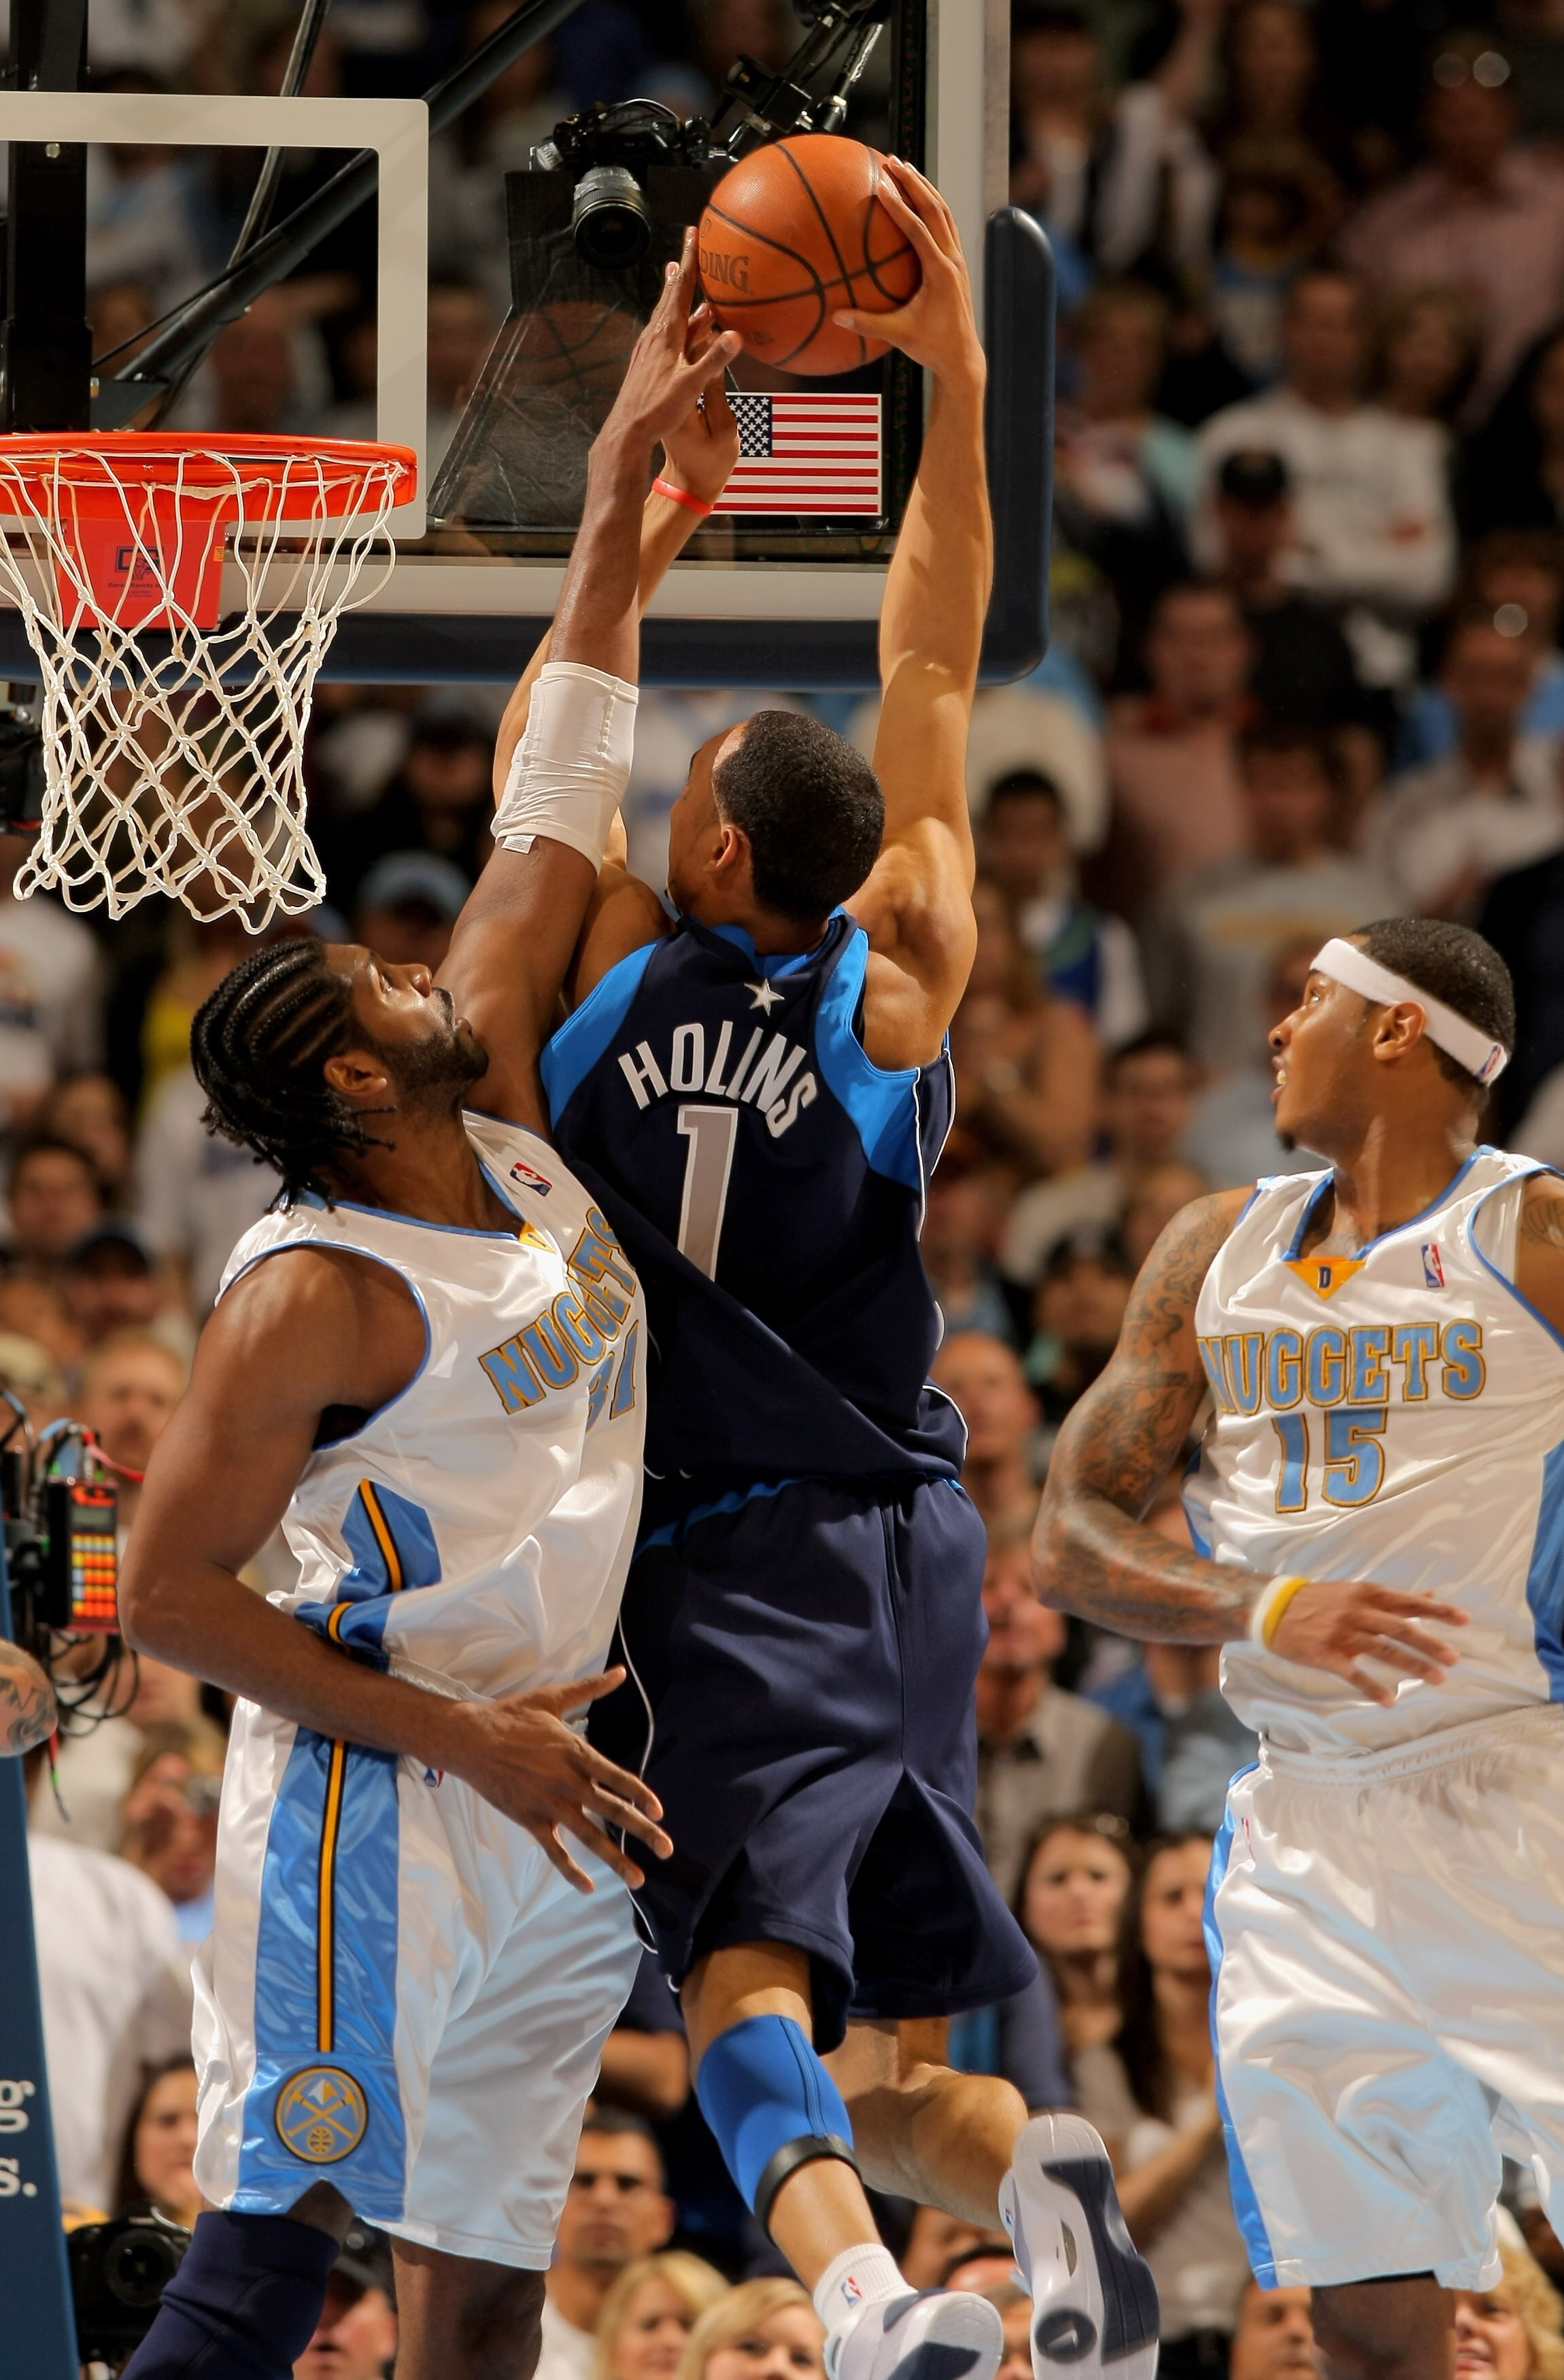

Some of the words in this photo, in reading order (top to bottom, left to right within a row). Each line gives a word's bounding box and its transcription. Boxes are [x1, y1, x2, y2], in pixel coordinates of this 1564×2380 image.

[677, 1104, 738, 1282] 1
[1319, 1265, 1331, 1289] D
[1197, 1318, 1486, 1415] NUGGETS
[1271, 1408, 1389, 1514] 15
